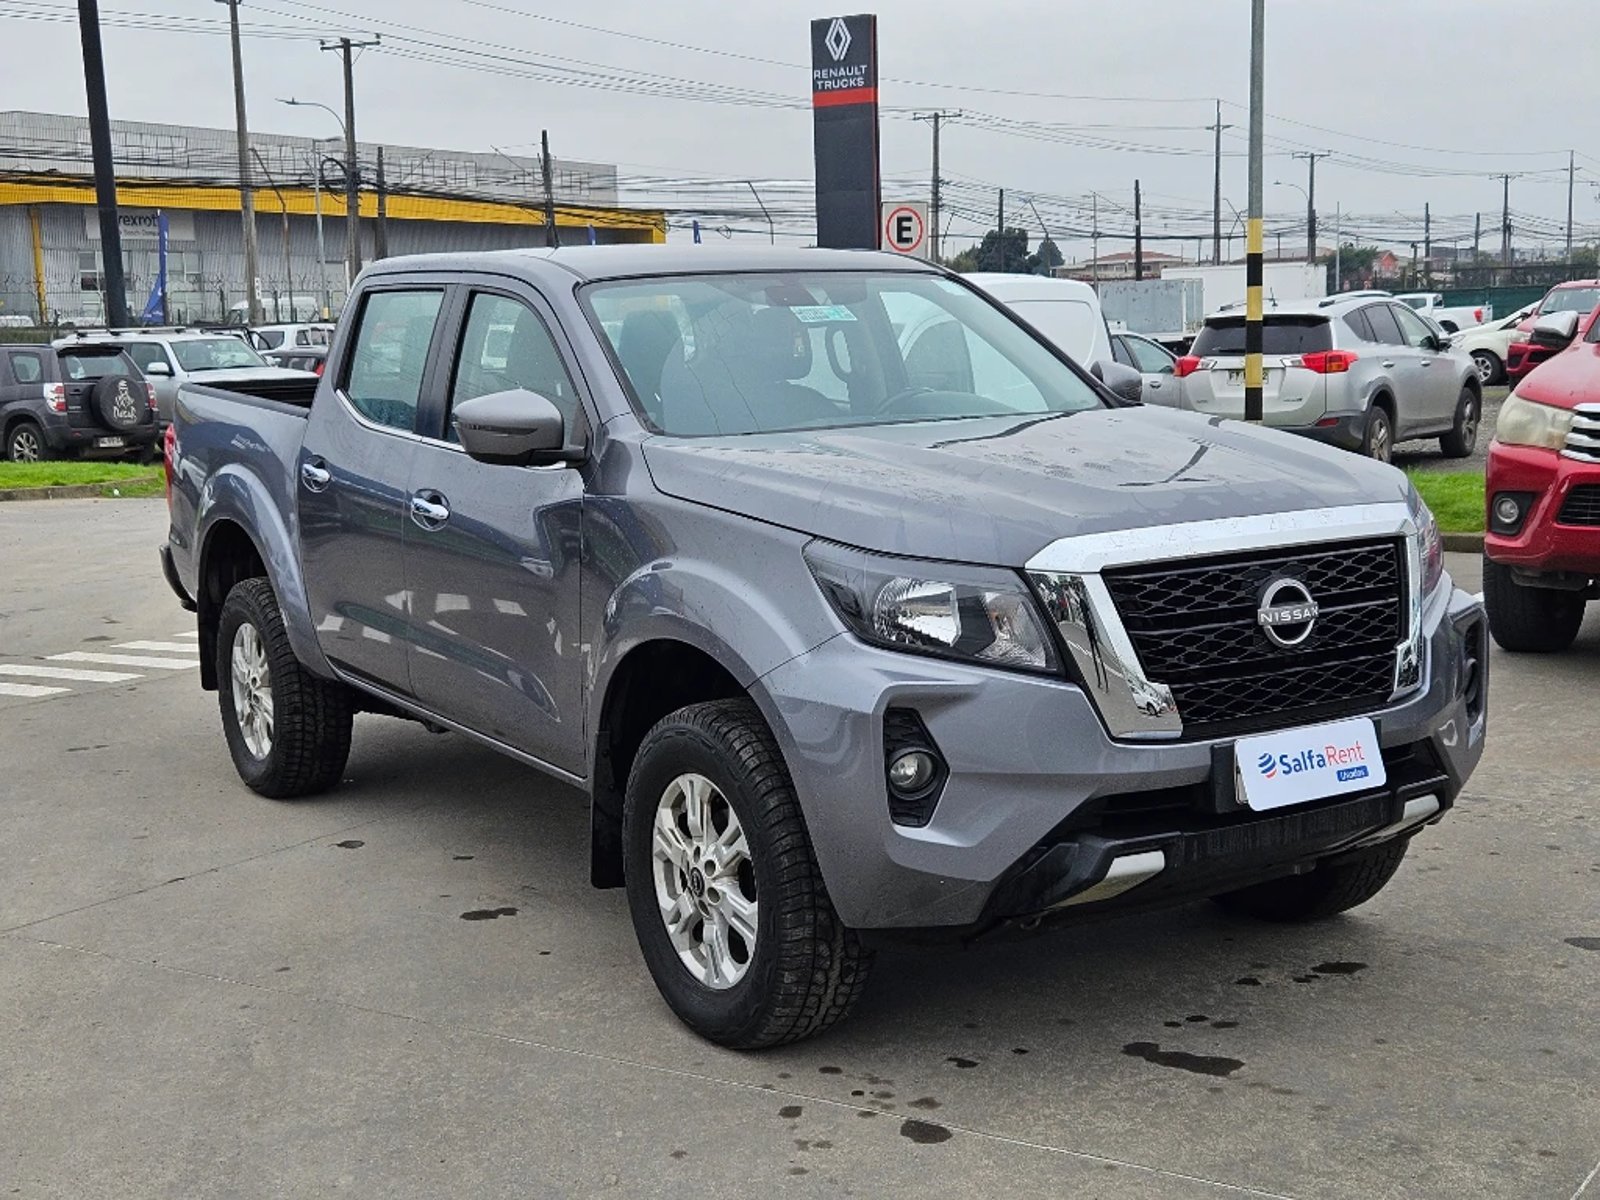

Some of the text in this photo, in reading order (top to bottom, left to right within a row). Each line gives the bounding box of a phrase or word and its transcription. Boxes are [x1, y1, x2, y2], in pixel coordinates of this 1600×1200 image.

[813, 64, 868, 80] RENAULT
[817, 77, 865, 90] TRUCKS
[118, 212, 159, 227] rexrot
[896, 216, 913, 244] E
[1260, 605, 1319, 623] NISSAN
[1279, 740, 1366, 775] SalfaRent
